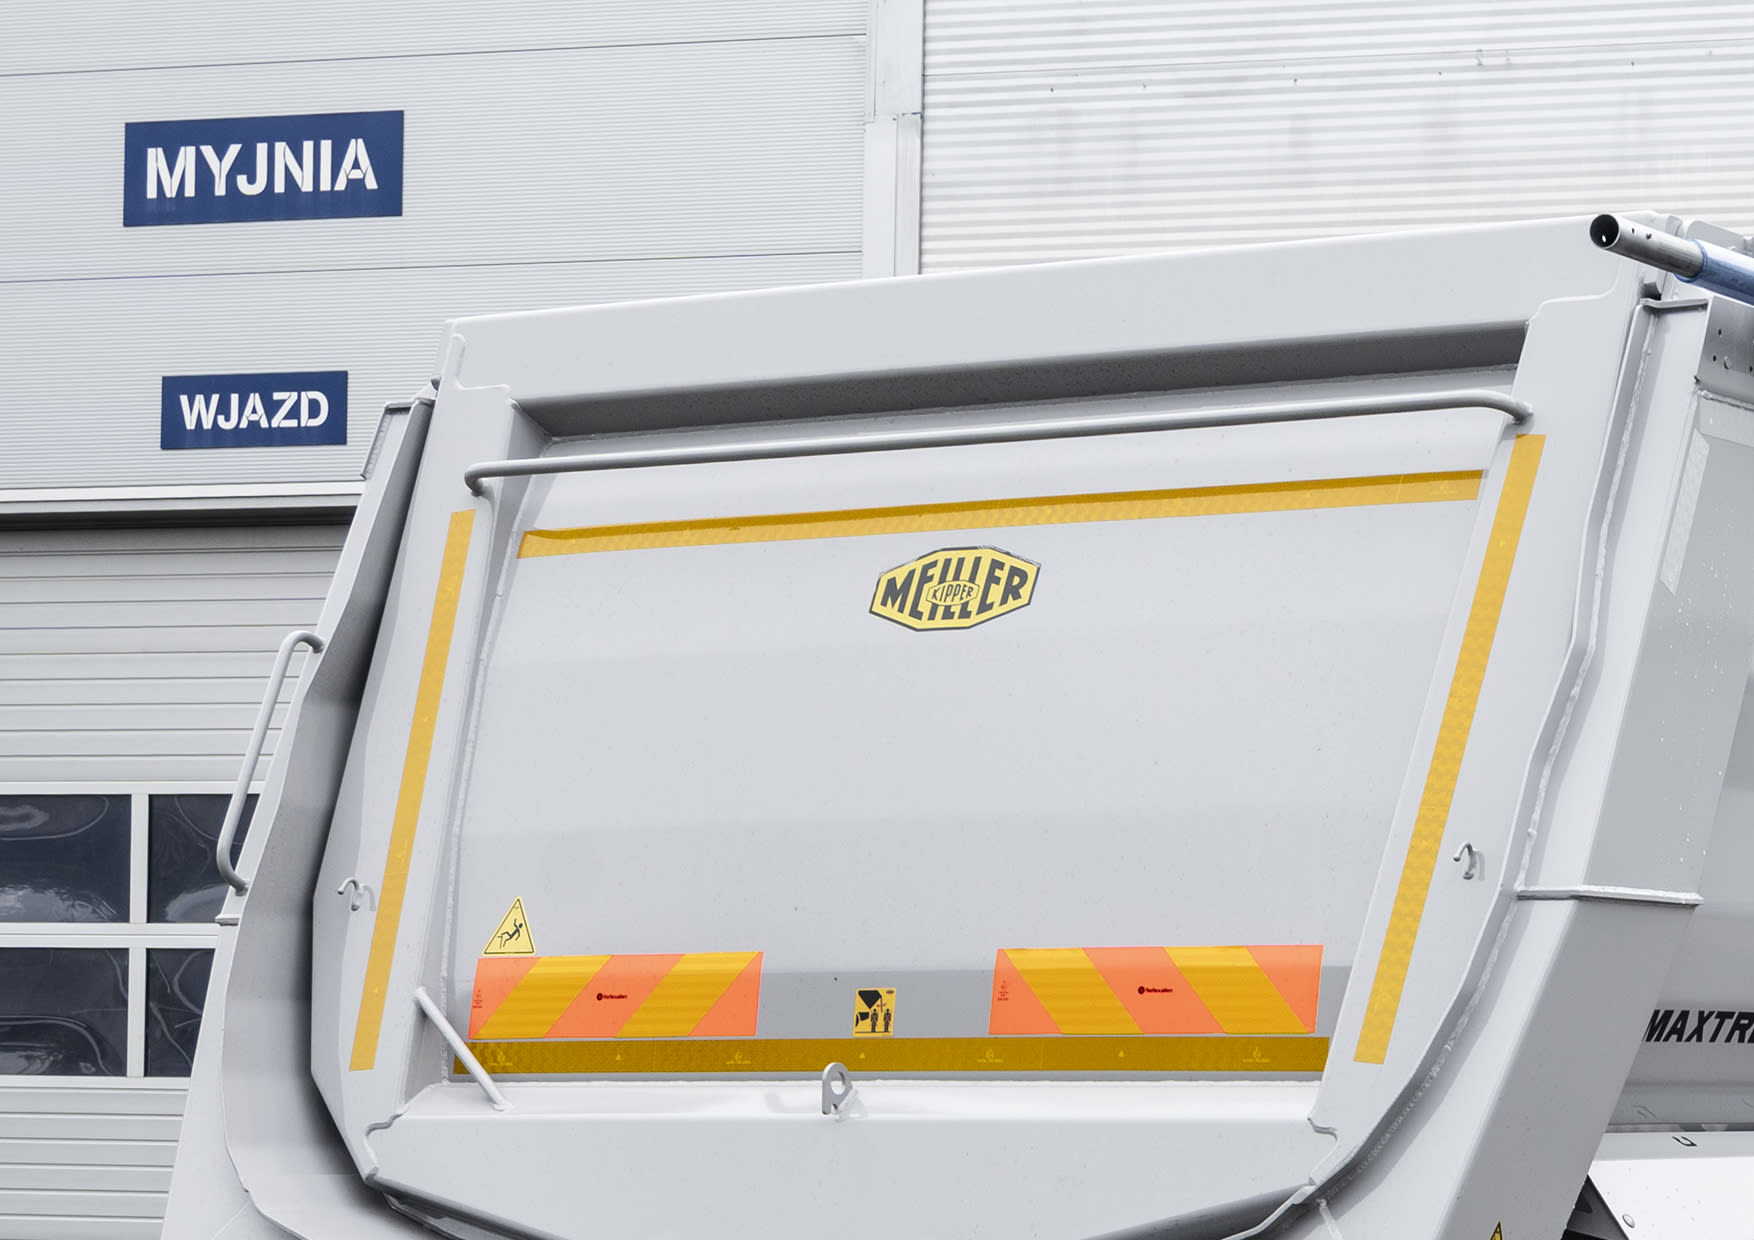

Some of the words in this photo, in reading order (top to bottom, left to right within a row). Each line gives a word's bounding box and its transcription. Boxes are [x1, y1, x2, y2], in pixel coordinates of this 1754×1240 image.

[145, 138, 379, 200] MYJNIA
[180, 391, 330, 431] WJAZD
[880, 556, 1029, 621] MEILLER
[931, 584, 974, 603] KIPPER
